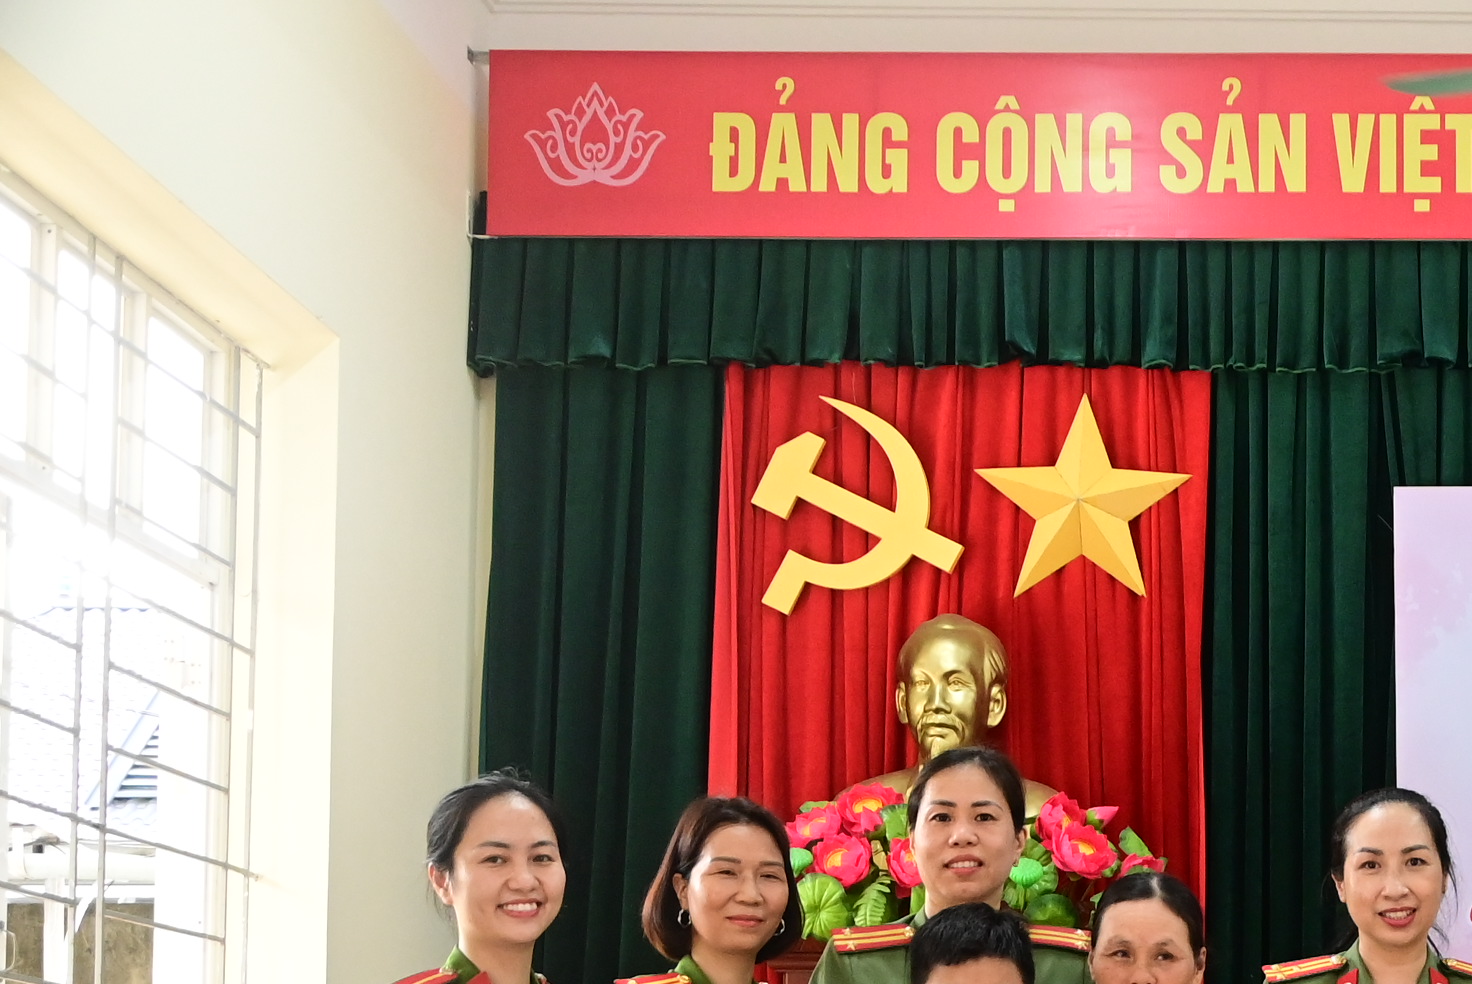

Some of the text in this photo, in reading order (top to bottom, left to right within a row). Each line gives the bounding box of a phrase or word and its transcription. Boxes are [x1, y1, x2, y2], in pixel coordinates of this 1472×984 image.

[710, 77, 908, 195] ĐẢNG
[935, 96, 1132, 212] CỘNG
[1158, 77, 1306, 194] SẢN
